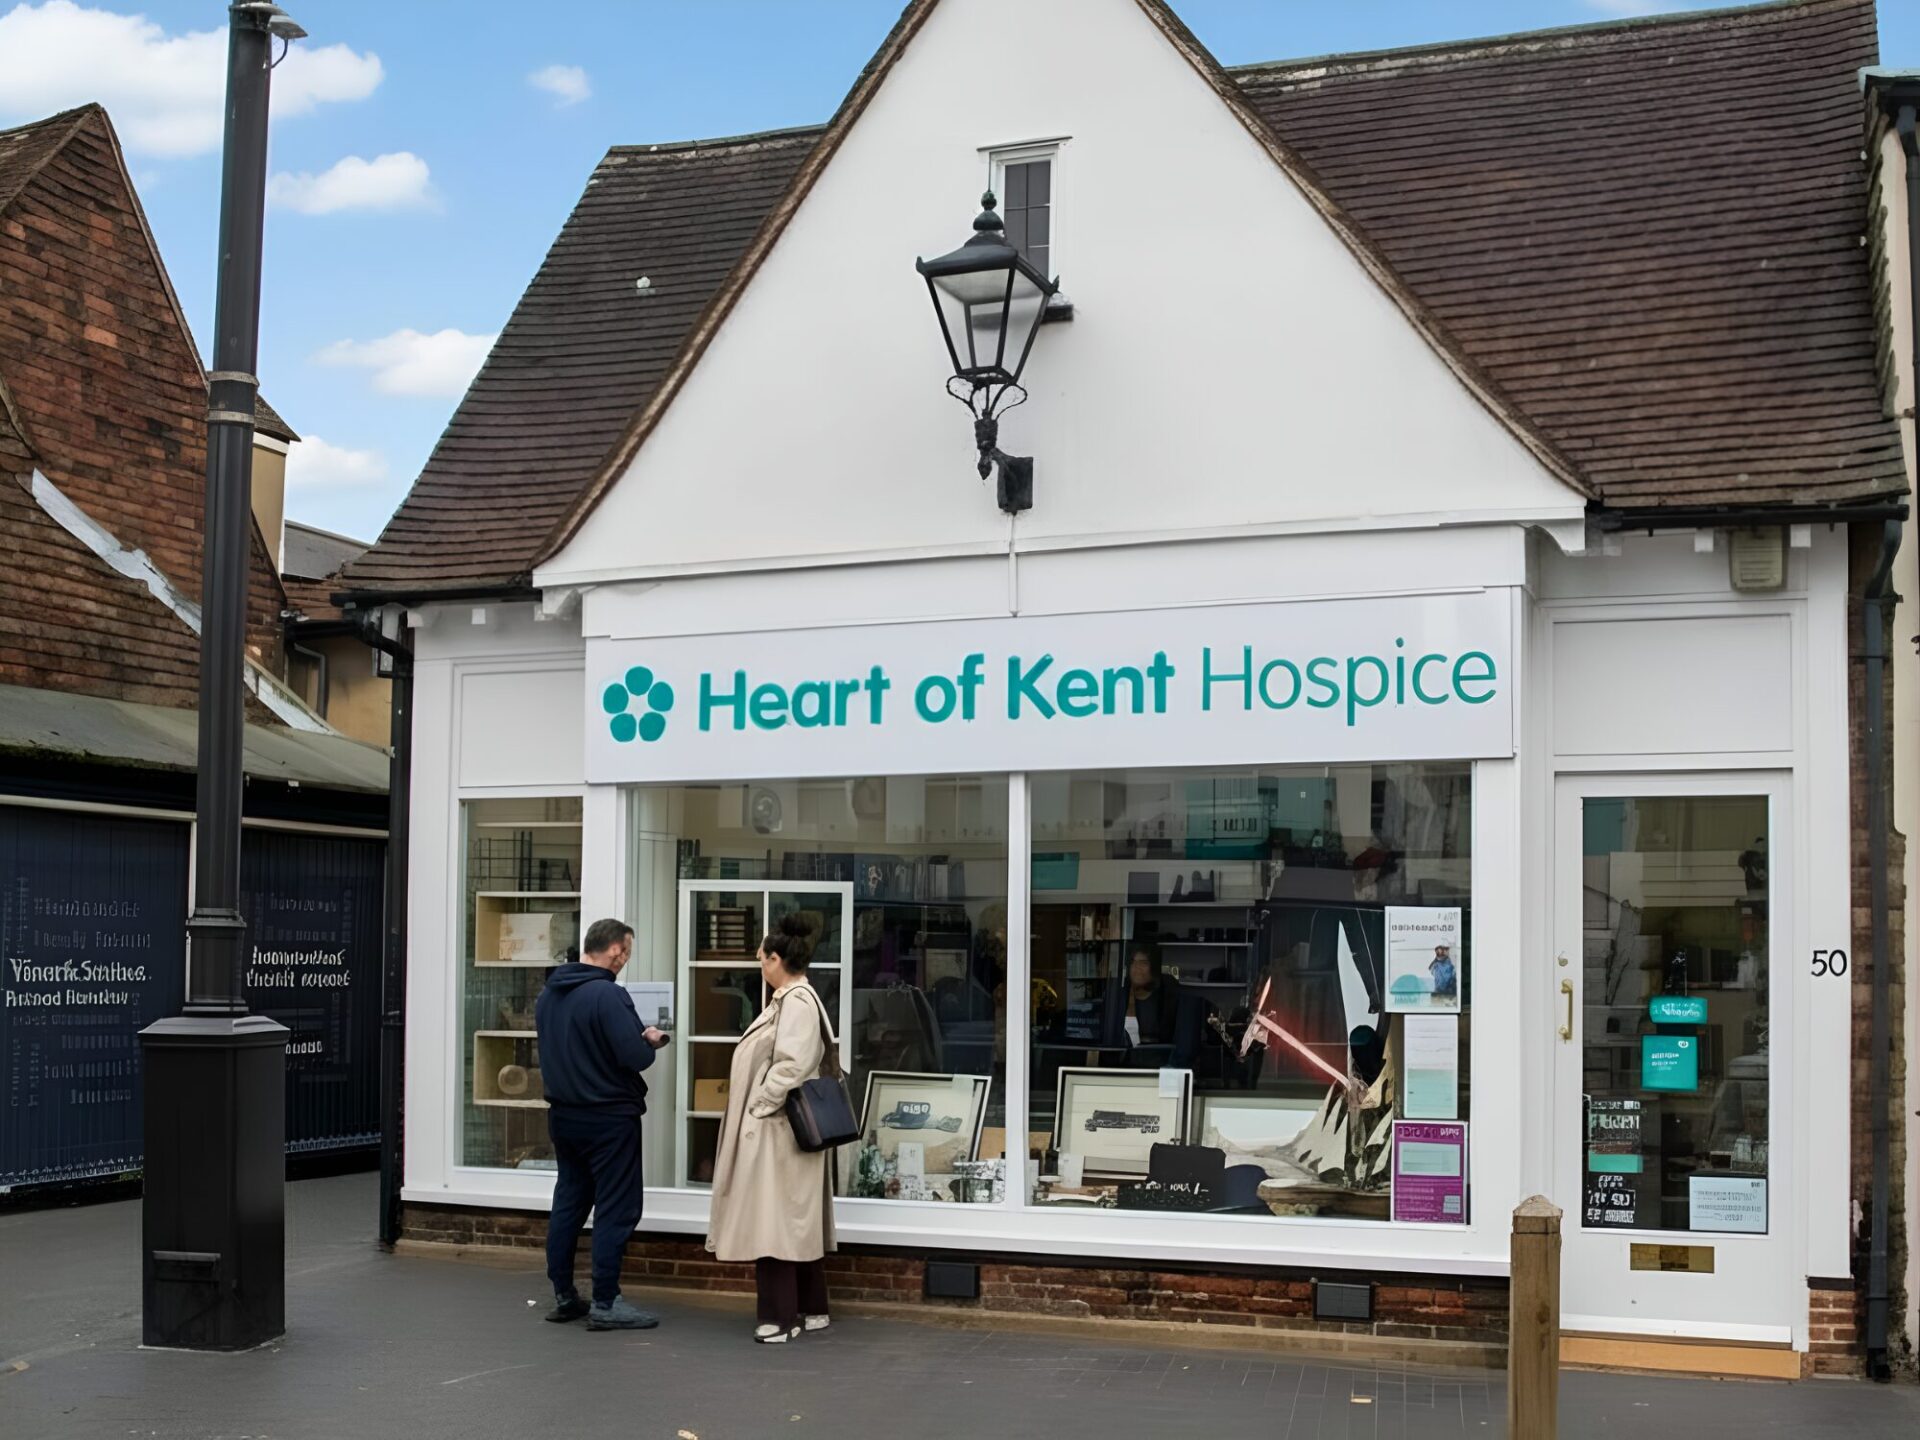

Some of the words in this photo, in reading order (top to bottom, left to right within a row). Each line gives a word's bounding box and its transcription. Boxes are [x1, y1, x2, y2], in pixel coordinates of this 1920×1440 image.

[699, 666, 890, 731] Heart
[915, 653, 984, 723] of
[1008, 651, 1175, 720] Kent
[1202, 639, 1496, 726] Hospice
[1812, 950, 1847, 976] 50
